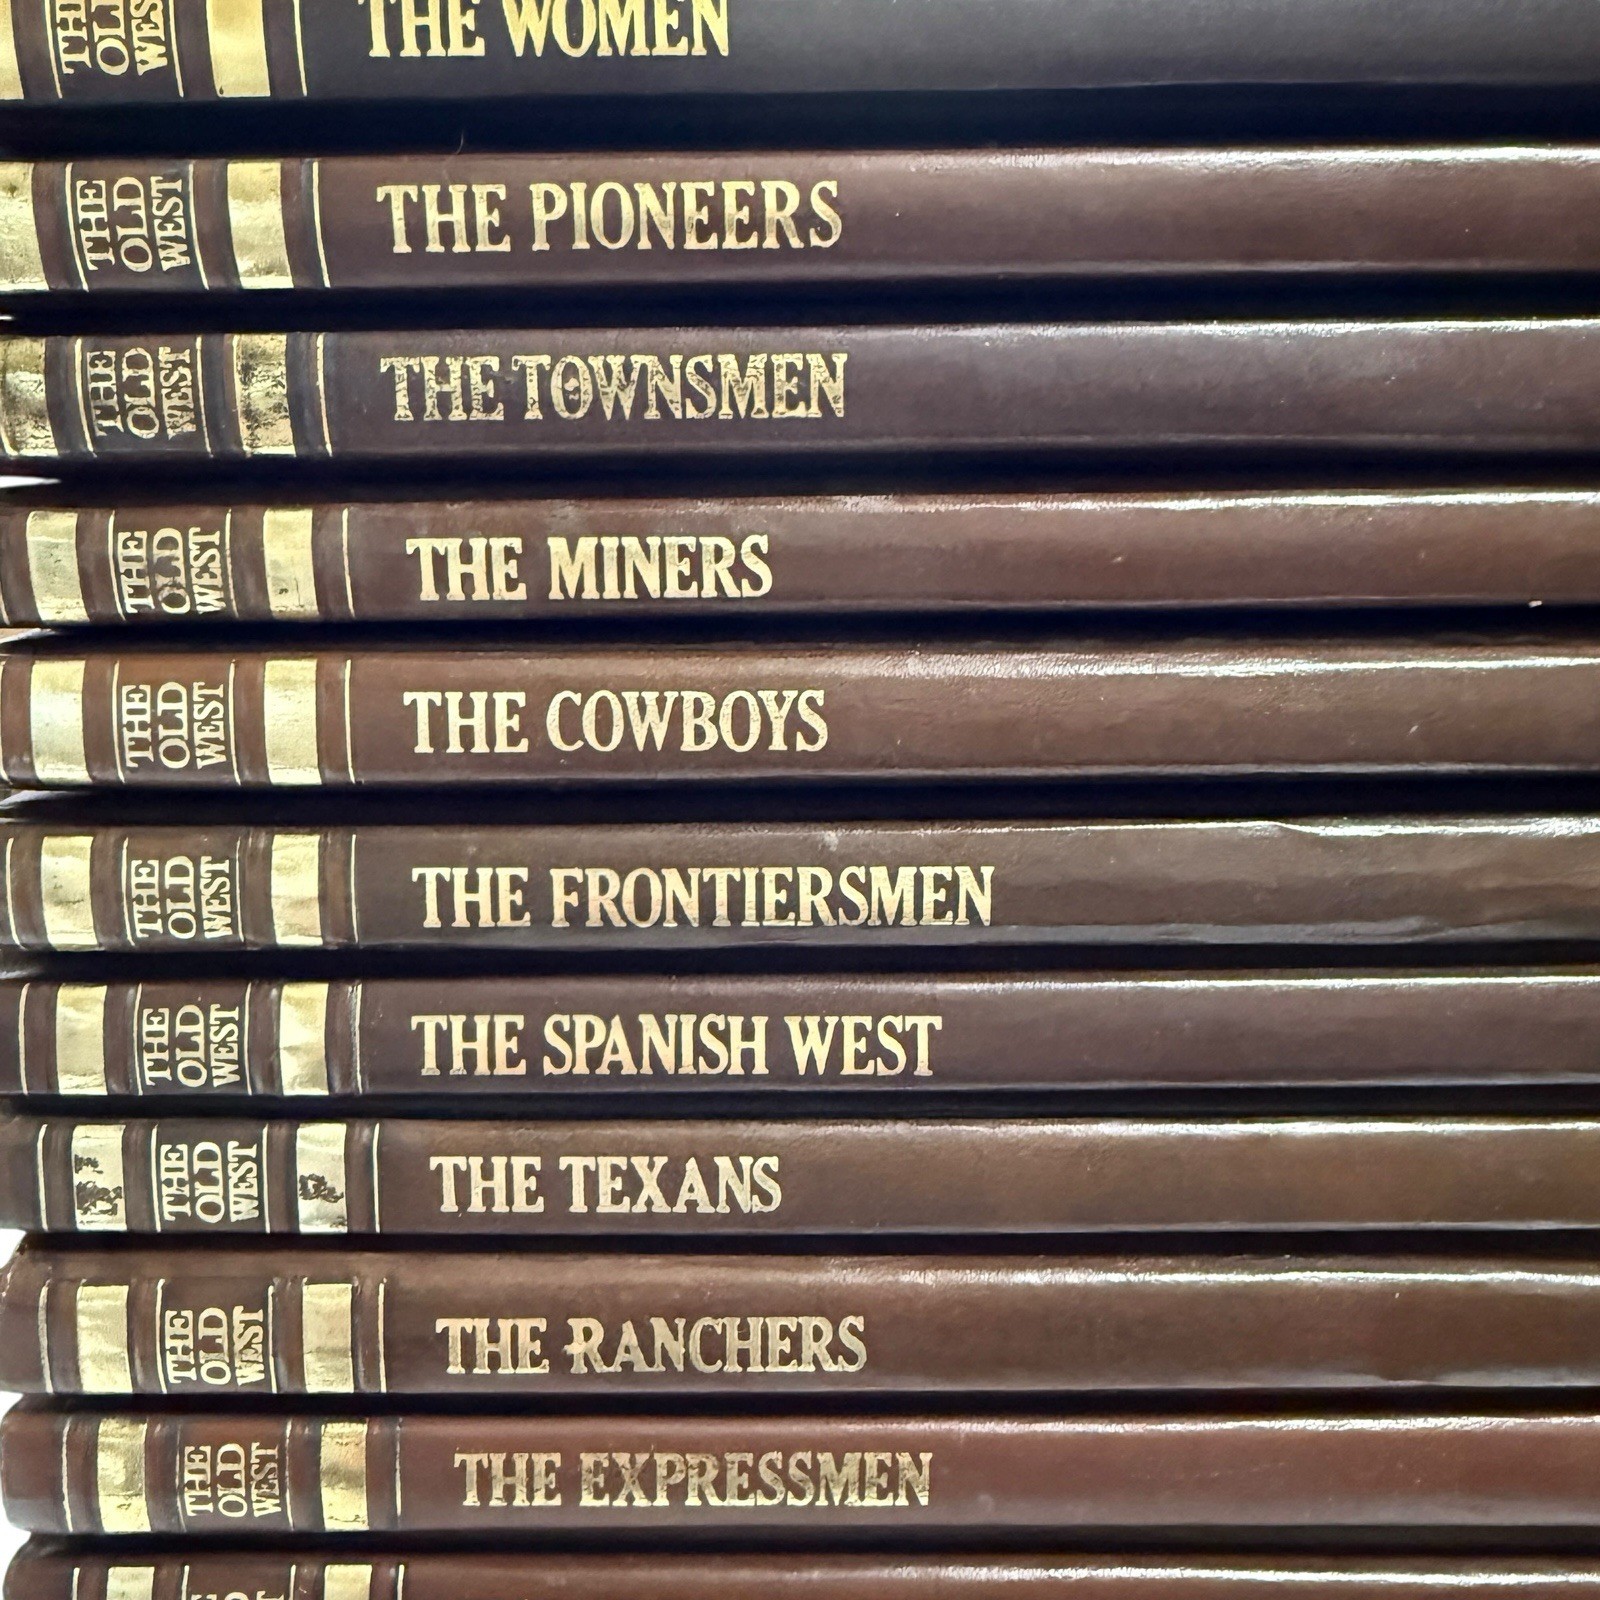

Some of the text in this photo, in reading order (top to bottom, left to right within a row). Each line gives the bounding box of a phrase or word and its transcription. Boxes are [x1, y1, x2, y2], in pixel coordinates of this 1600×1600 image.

[56, 0, 92, 75] TH
[90, 0, 130, 76] OL
[129, 0, 171, 76] WES
[357, 0, 729, 58] THE WOMEN
[76, 179, 116, 272] THE
[113, 176, 153, 273] OLD
[150, 175, 191, 272] WEST
[376, 179, 842, 254] THE PIONEERS
[86, 350, 124, 438] THE
[121, 347, 159, 439] OLD
[158, 346, 197, 440] WEST
[379, 352, 848, 422] THE TOWNSMEN
[117, 530, 155, 614] THE
[153, 527, 191, 615] OLD
[188, 527, 227, 614] WEST
[405, 533, 773, 601] THE MINERS
[121, 684, 154, 768] THE
[156, 681, 191, 769] OLD
[192, 681, 227, 770] WEST
[402, 689, 828, 754] THE COWBOYS
[130, 859, 163, 938] THE
[164, 855, 197, 940] OLD
[199, 855, 233, 939] WEST
[411, 865, 996, 928] THE FRONTIERSMEN
[142, 1007, 173, 1086] THE
[175, 1004, 208, 1088] OLD
[208, 1003, 240, 1088] WEST
[410, 1013, 943, 1076] THE SPANISH WEST
[159, 1143, 192, 1221] THE
[192, 1141, 225, 1224] OLD
[227, 1140, 260, 1223] WEST
[429, 1155, 782, 1214] THE TEXANS
[164, 1309, 198, 1384] THE
[197, 1307, 232, 1386] OLD
[232, 1305, 265, 1387] WEST
[435, 1315, 867, 1375] THE RANCHERS
[183, 1445, 214, 1517] THE
[216, 1443, 248, 1518] OLD
[250, 1441, 282, 1518] WEST
[453, 1450, 933, 1508] THE EXPRESSMEN
